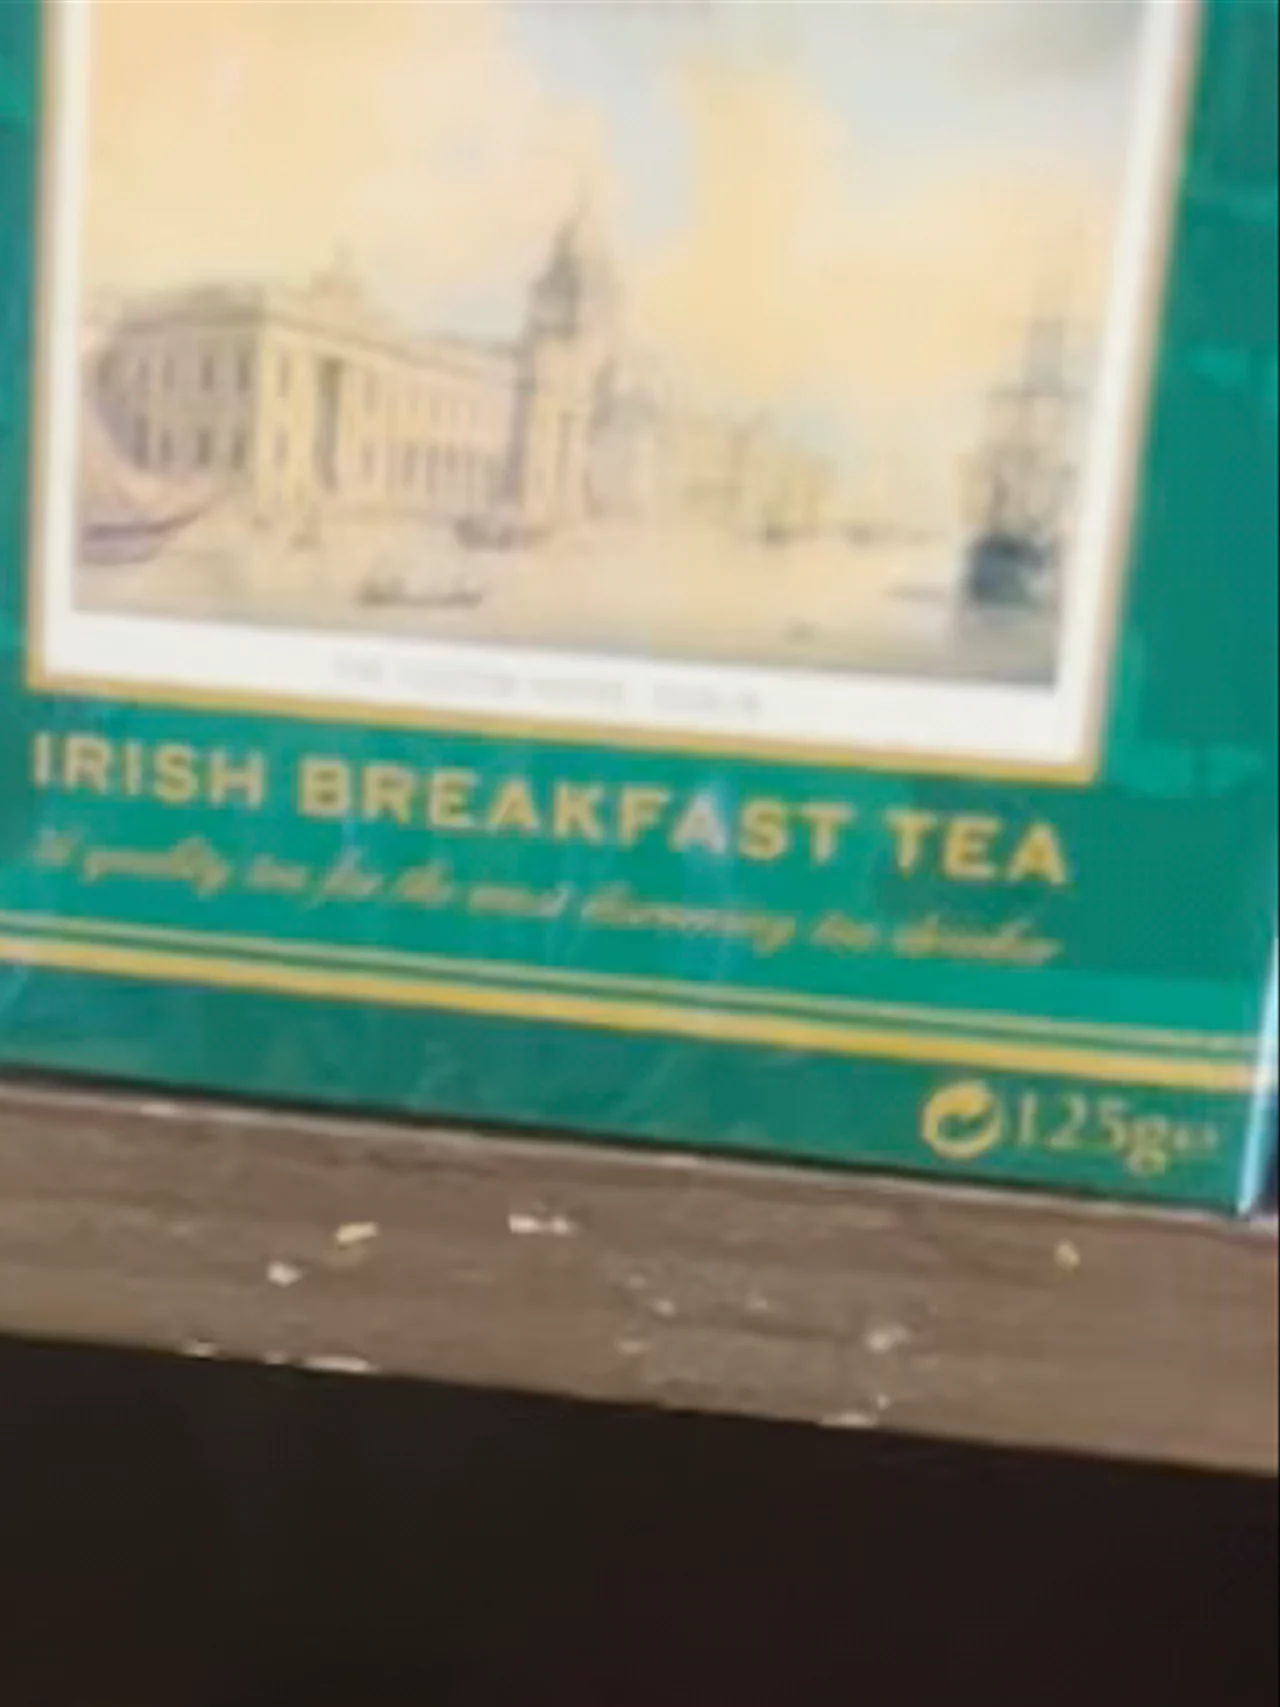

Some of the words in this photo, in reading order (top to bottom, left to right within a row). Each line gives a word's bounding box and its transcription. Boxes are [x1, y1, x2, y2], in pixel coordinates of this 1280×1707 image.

[32, 731, 267, 809] IRISH
[296, 754, 854, 864] BREAKFAST
[884, 807, 1068, 886] TEA
